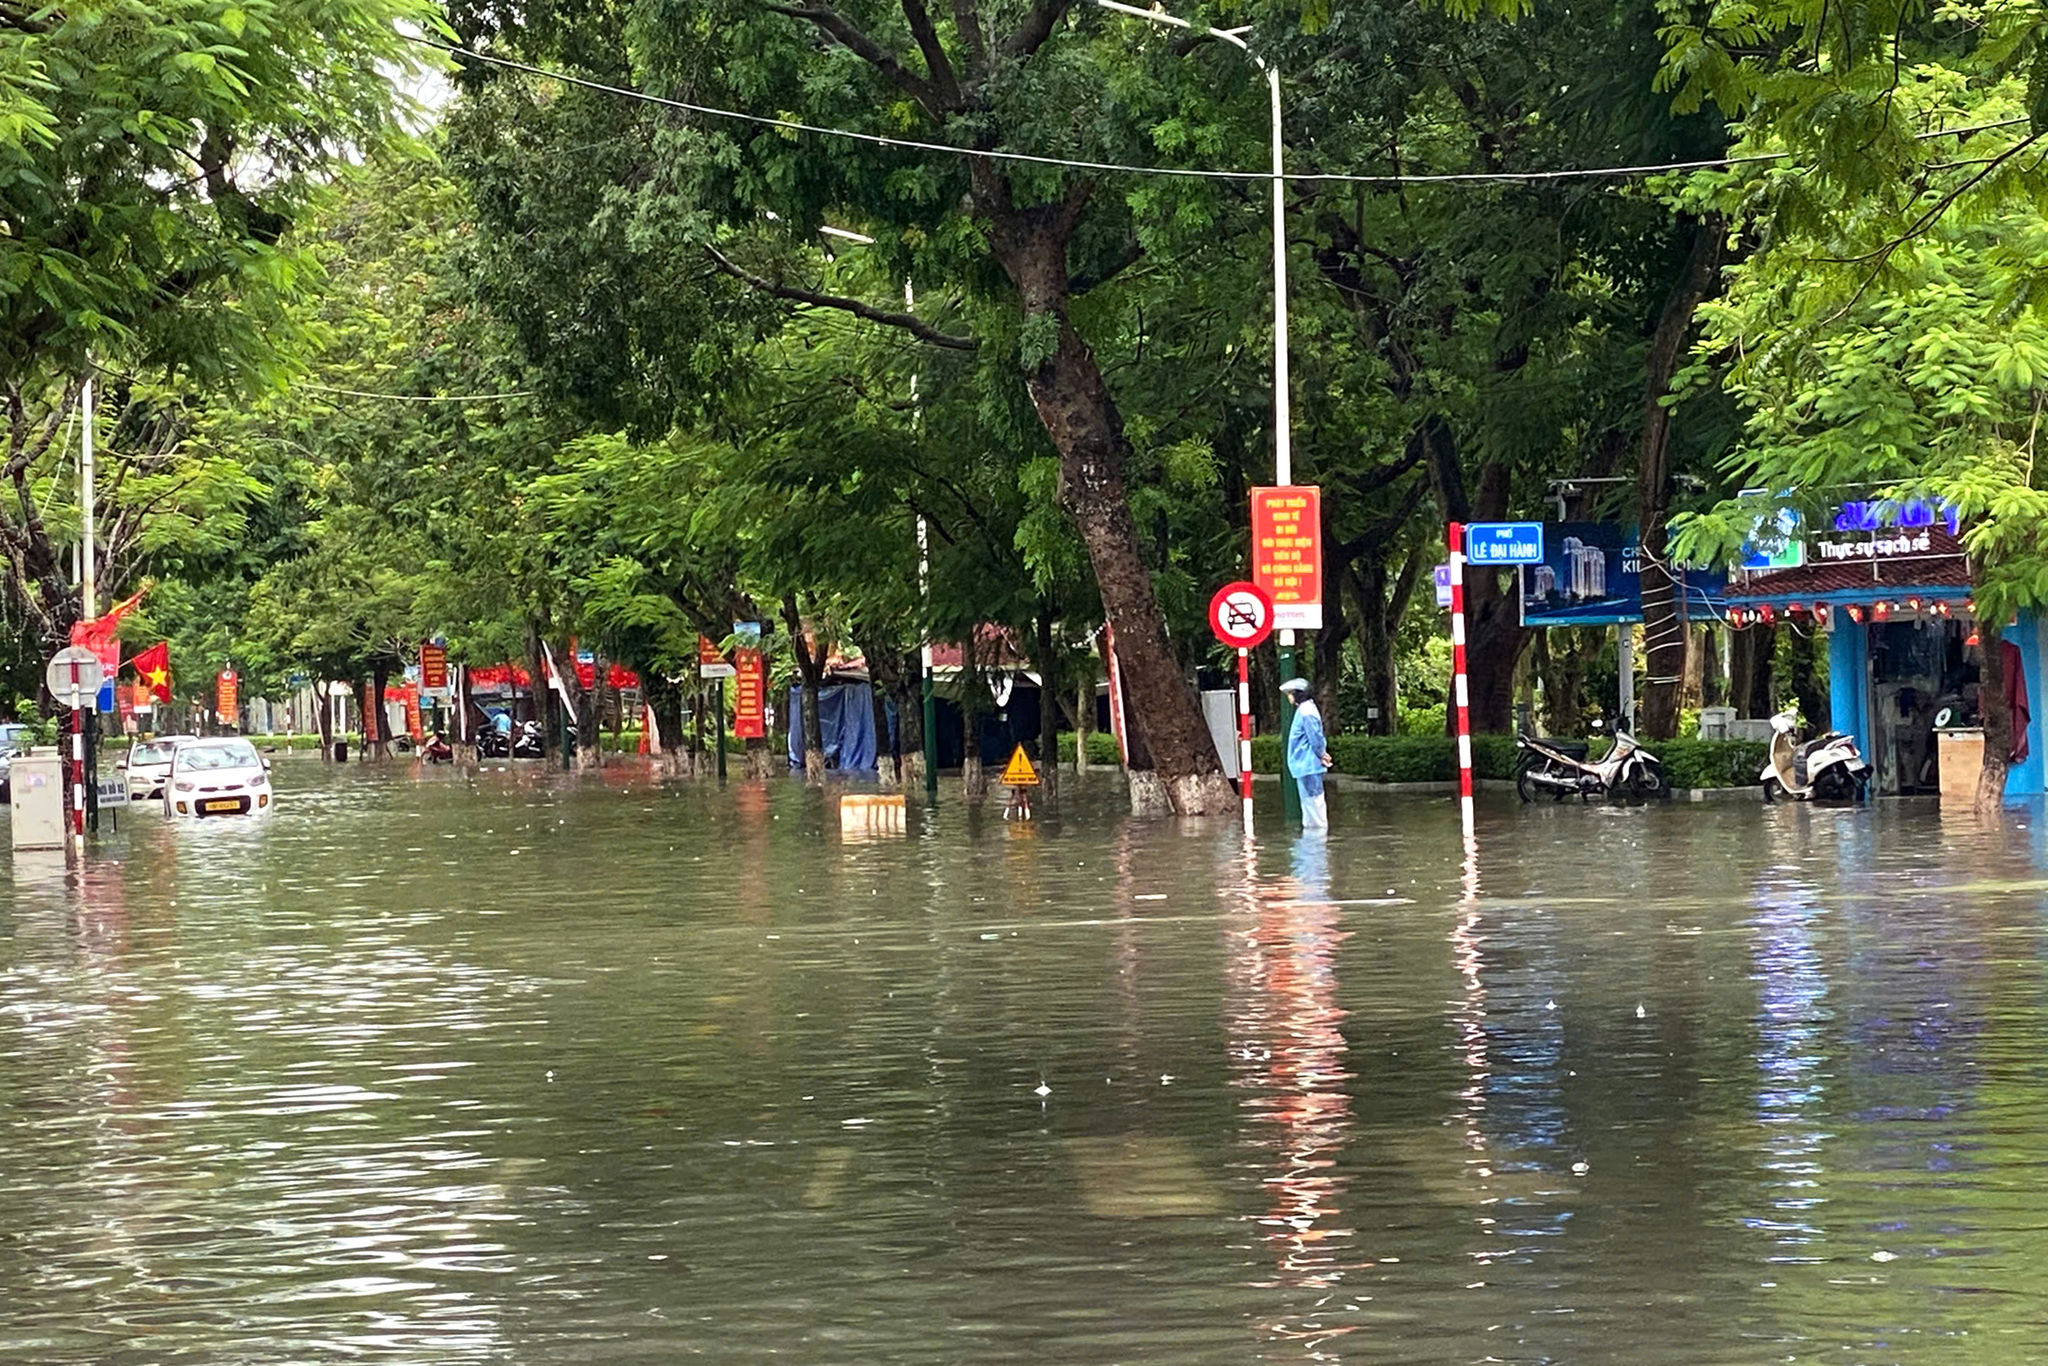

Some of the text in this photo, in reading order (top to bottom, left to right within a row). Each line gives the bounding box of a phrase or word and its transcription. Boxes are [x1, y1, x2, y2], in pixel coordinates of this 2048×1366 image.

[1474, 540, 1537, 560] LÊ ĐẠI HÀNH
[1876, 535, 1910, 556] sạch
